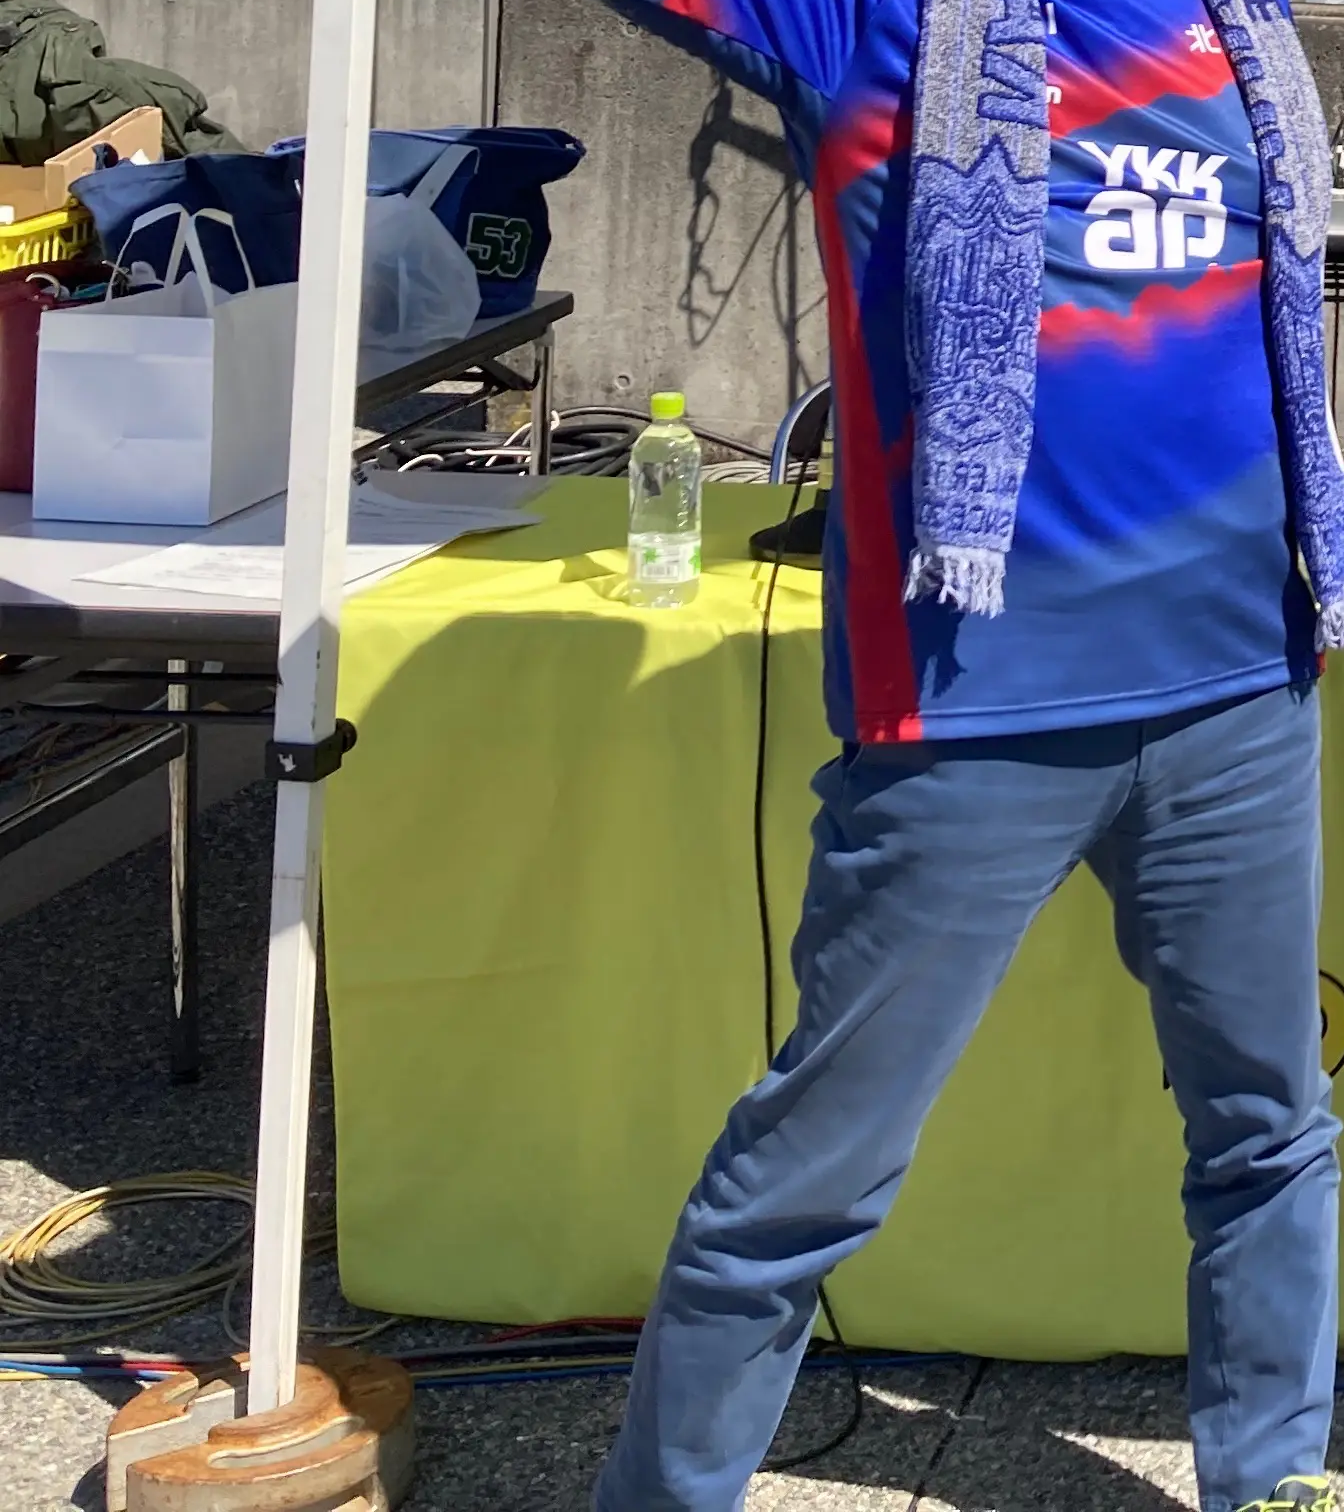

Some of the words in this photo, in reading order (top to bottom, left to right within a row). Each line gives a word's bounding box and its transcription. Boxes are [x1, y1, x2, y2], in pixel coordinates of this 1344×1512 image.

[1077, 140, 1229, 204] YKK
[464, 213, 533, 279] 53
[1083, 190, 1228, 270] ap
